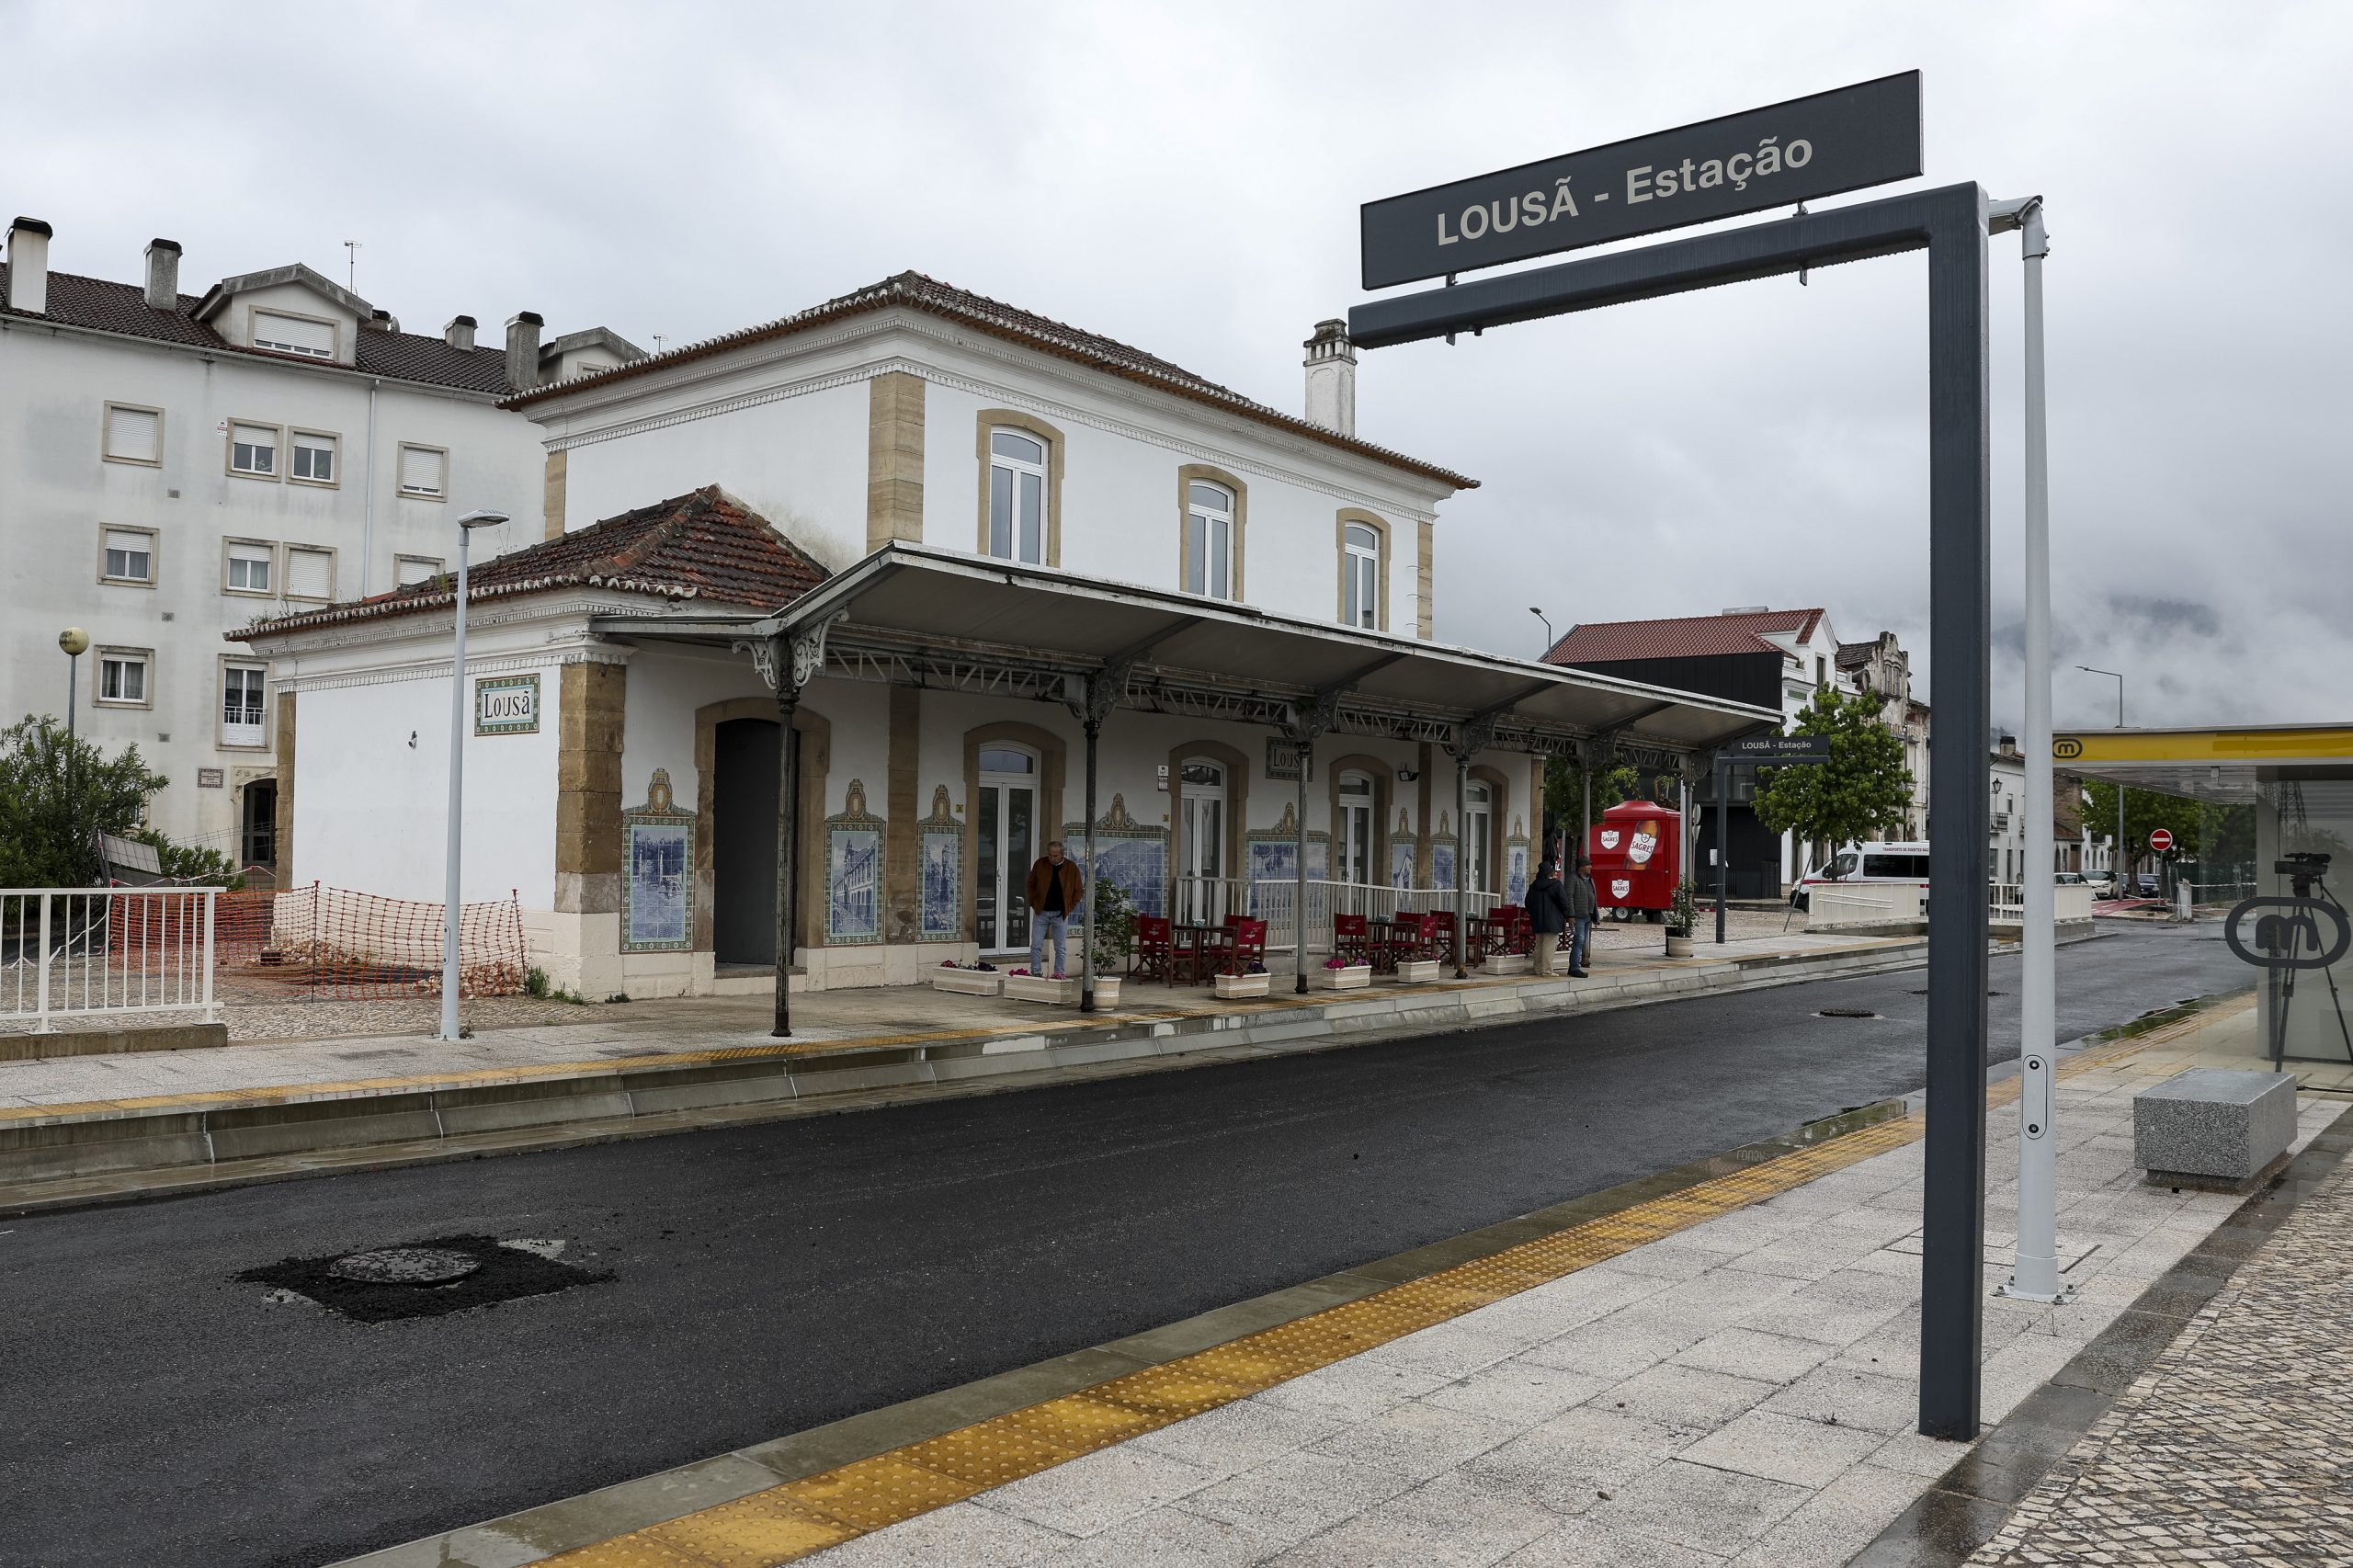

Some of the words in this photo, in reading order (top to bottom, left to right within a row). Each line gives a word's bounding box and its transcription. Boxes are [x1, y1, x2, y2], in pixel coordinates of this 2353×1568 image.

[1437, 176, 1579, 246] LOUSÃ
[1595, 192, 1608, 203] -
[1626, 136, 1813, 206] Estação
[484, 691, 530, 718] Lousã
[1742, 740, 1770, 749] LOUSÃ
[1779, 741, 1812, 750] Estação
[1273, 748, 1300, 767] Lous
[1631, 841, 1654, 854] SAGRES
